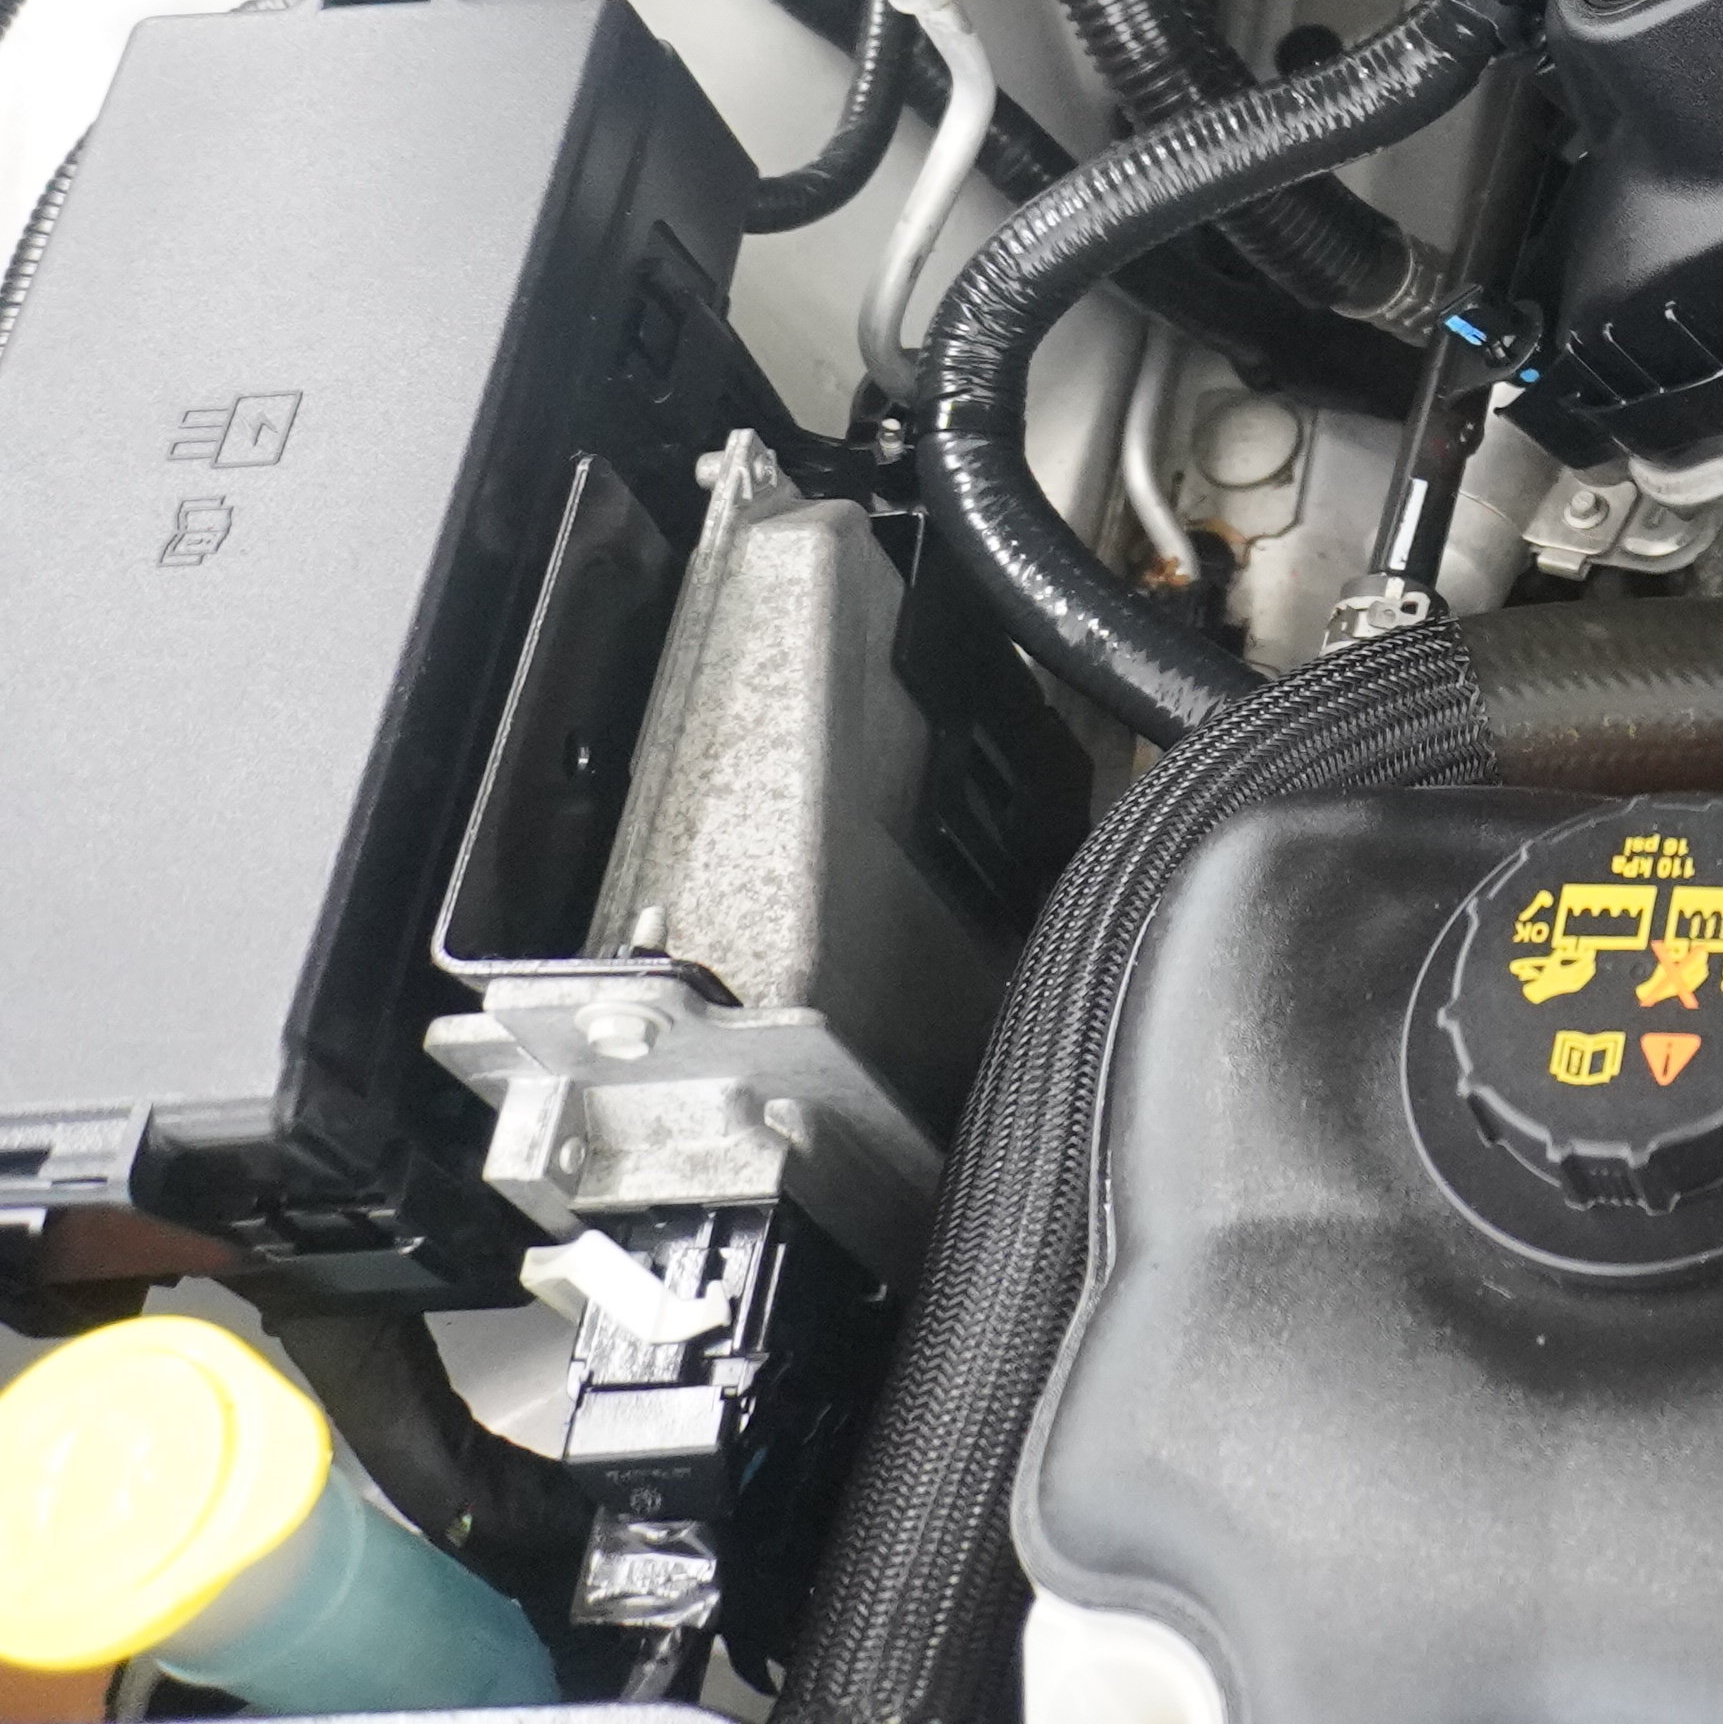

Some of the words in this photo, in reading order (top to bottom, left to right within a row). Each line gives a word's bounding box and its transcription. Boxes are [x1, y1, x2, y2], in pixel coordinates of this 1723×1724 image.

[1623, 833, 1660, 855] psi
[1663, 836, 1690, 855] 16
[1611, 854, 1653, 879] kPa
[1656, 856, 1696, 879] 110
[1512, 920, 1549, 943] OK
